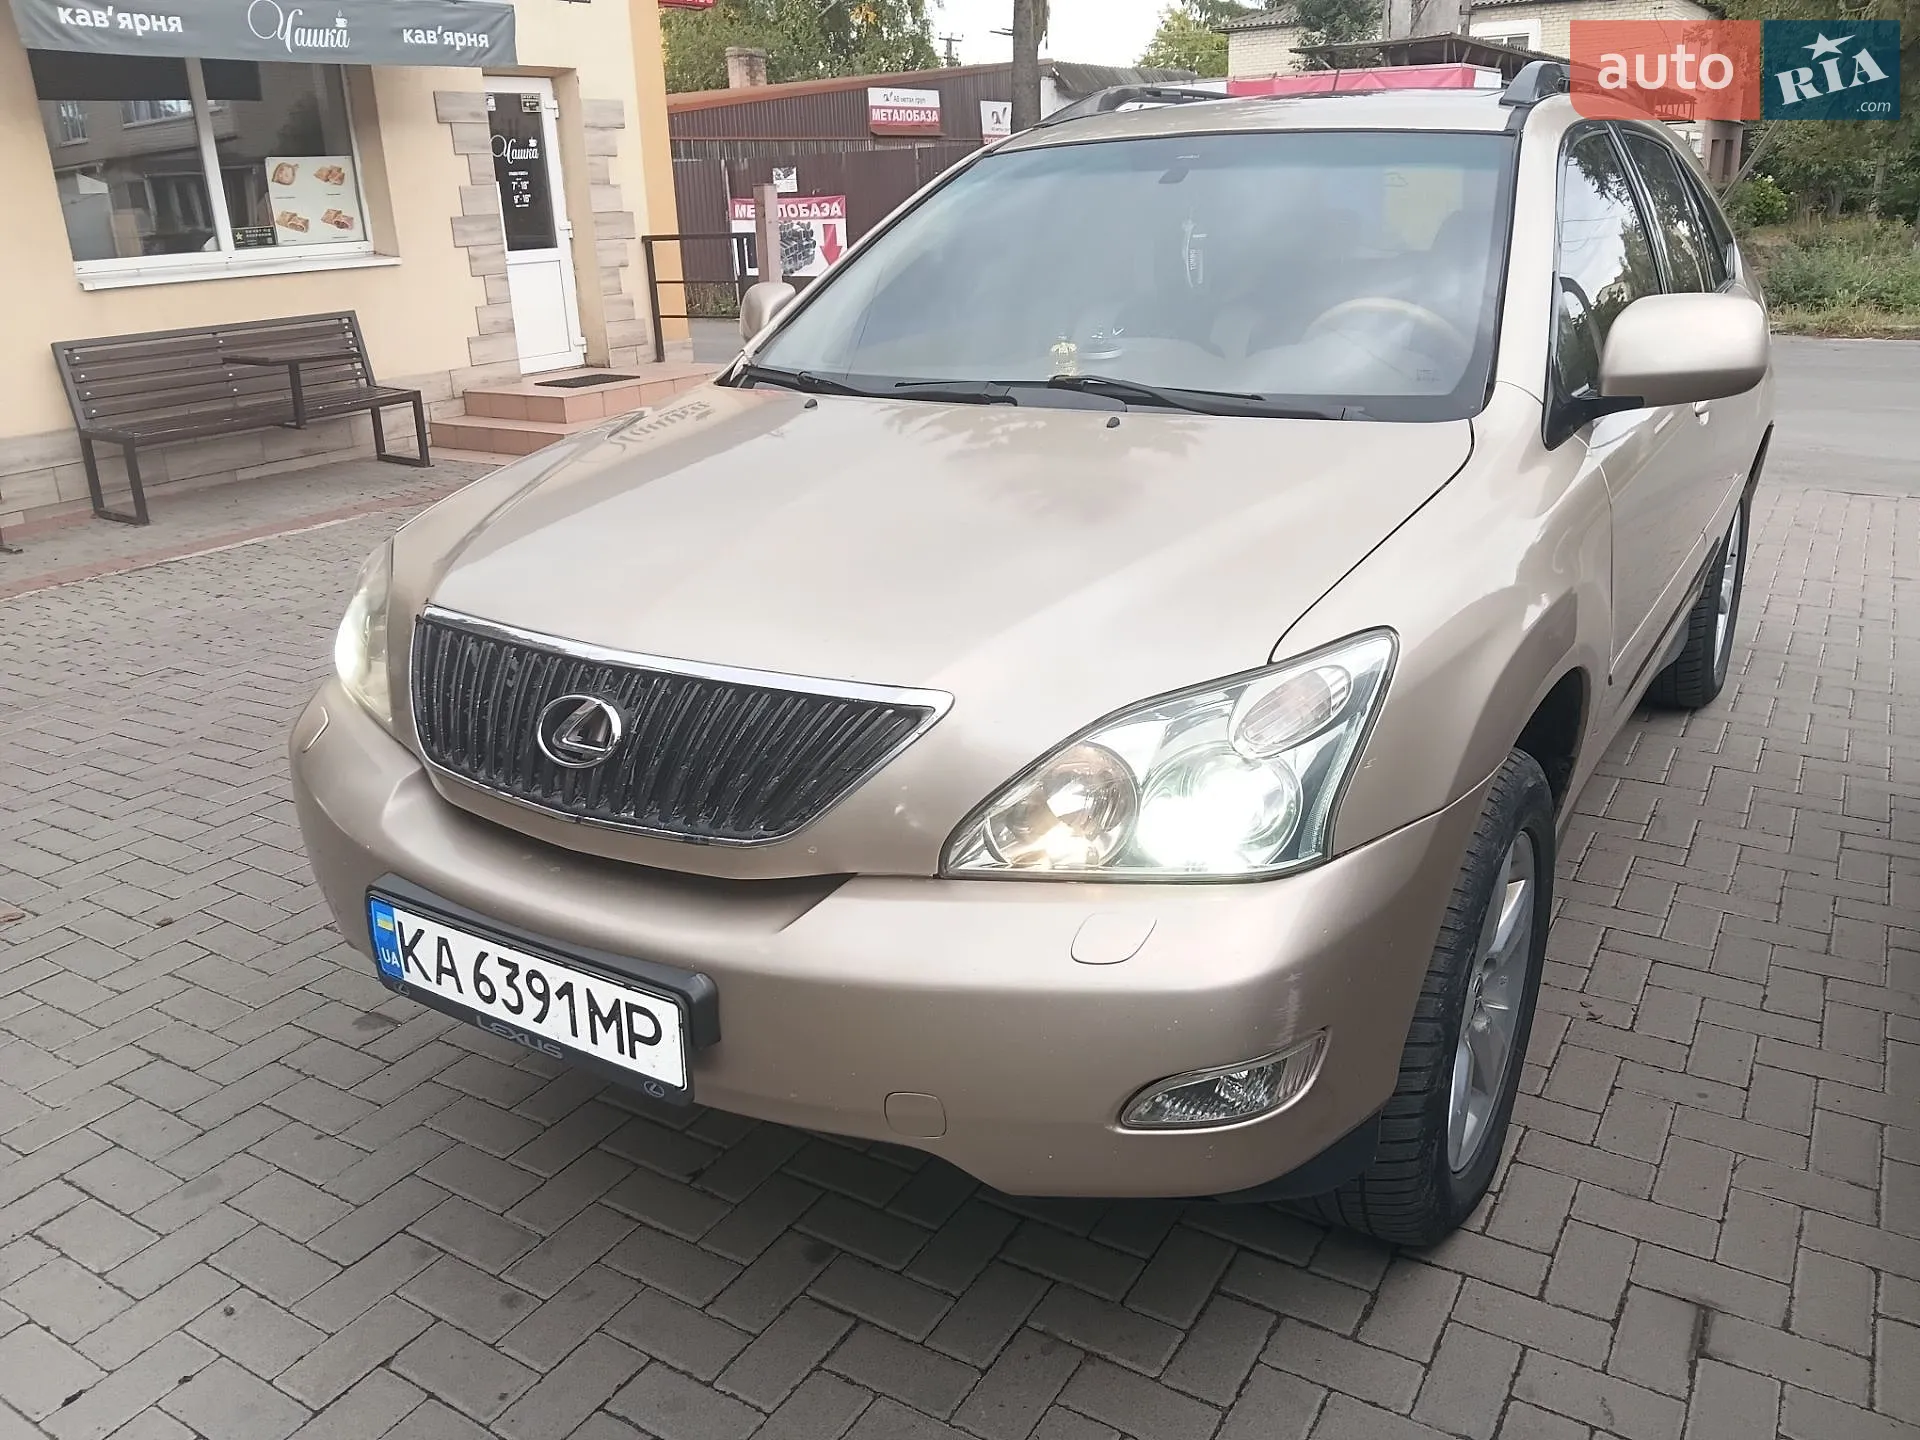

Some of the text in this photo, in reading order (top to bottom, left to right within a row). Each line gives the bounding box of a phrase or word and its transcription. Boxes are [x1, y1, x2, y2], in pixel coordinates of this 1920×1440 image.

[57, 6, 183, 36] кав'ярня
[248, 0, 350, 52] Чашка
[403, 27, 489, 50] кав'ярня
[872, 109, 939, 122] МЕТАЛОБАЗА
[490, 135, 539, 164] Чашка
[735, 202, 842, 218] МЕЛОБАЗА
[382, 947, 399, 967] UA
[473, 952, 578, 1037] 6391
[475, 1016, 564, 1059] LEXUS
